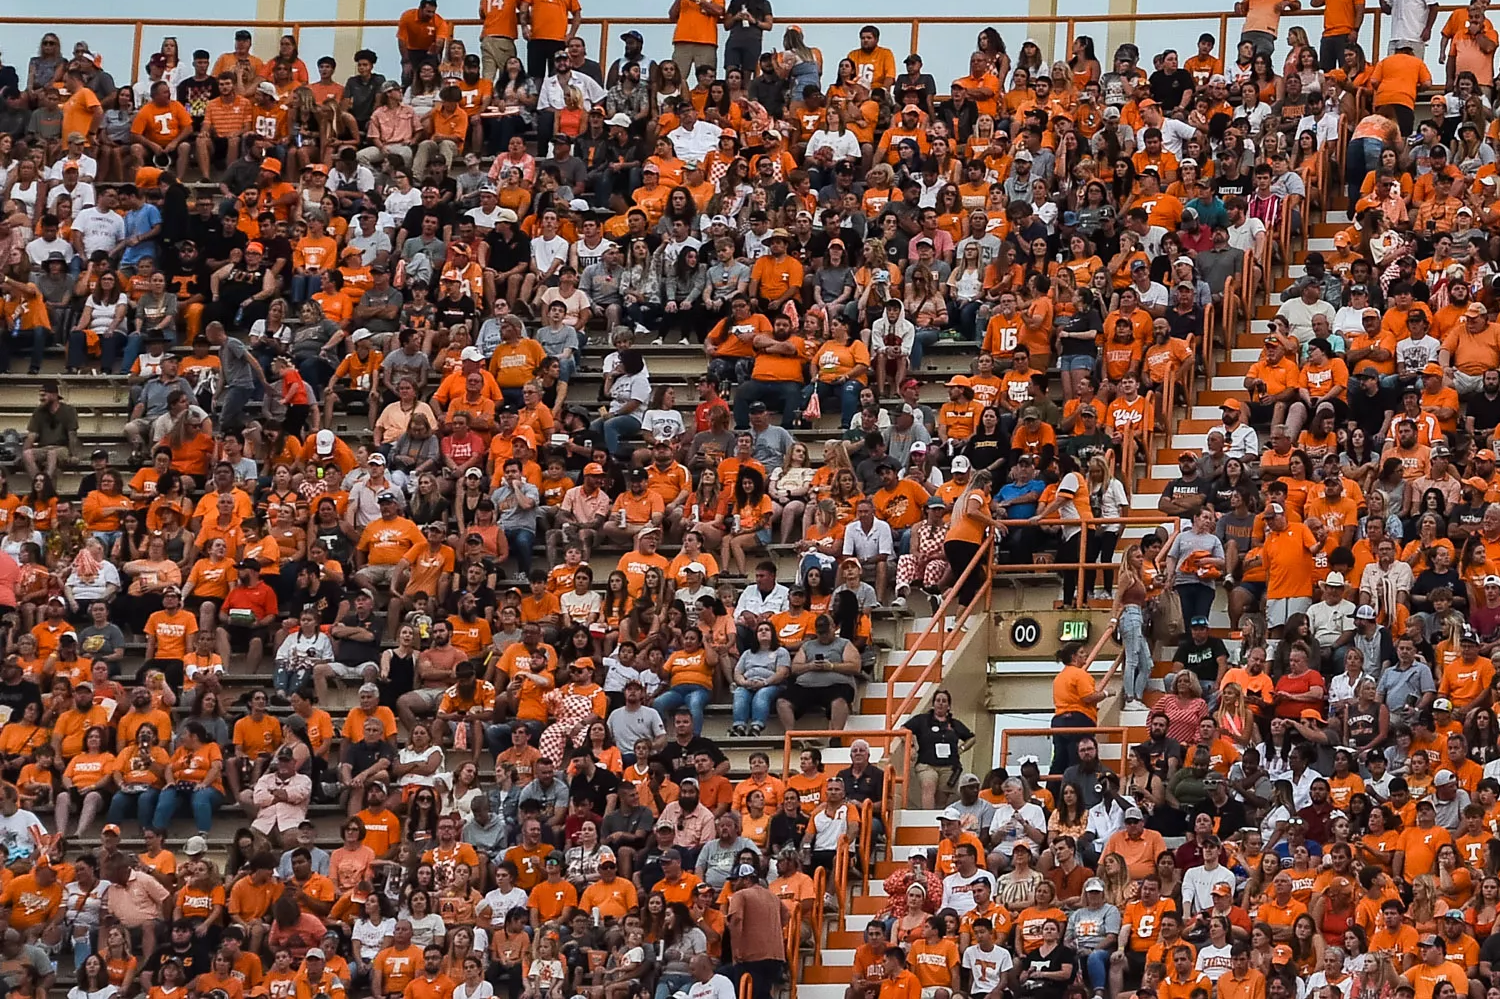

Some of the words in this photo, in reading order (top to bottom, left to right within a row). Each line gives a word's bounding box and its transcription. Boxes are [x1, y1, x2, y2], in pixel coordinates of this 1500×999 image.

[461, 89, 478, 107] T
[154, 113, 172, 134] T
[803, 115, 819, 130] T
[873, 203, 882, 211] T
[1142, 201, 1157, 213] T
[172, 275, 197, 297] T
[1000, 328, 1017, 351] 16
[320, 535, 338, 549] T
[1015, 625, 1036, 642] 00
[1062, 620, 1086, 638] EXIT
[796, 824, 805, 833] T
[1466, 843, 1481, 861] T
[556, 891, 563, 900] T
[386, 957, 410, 977] T
[974, 959, 996, 982] T
[1029, 960, 1051, 972] T
